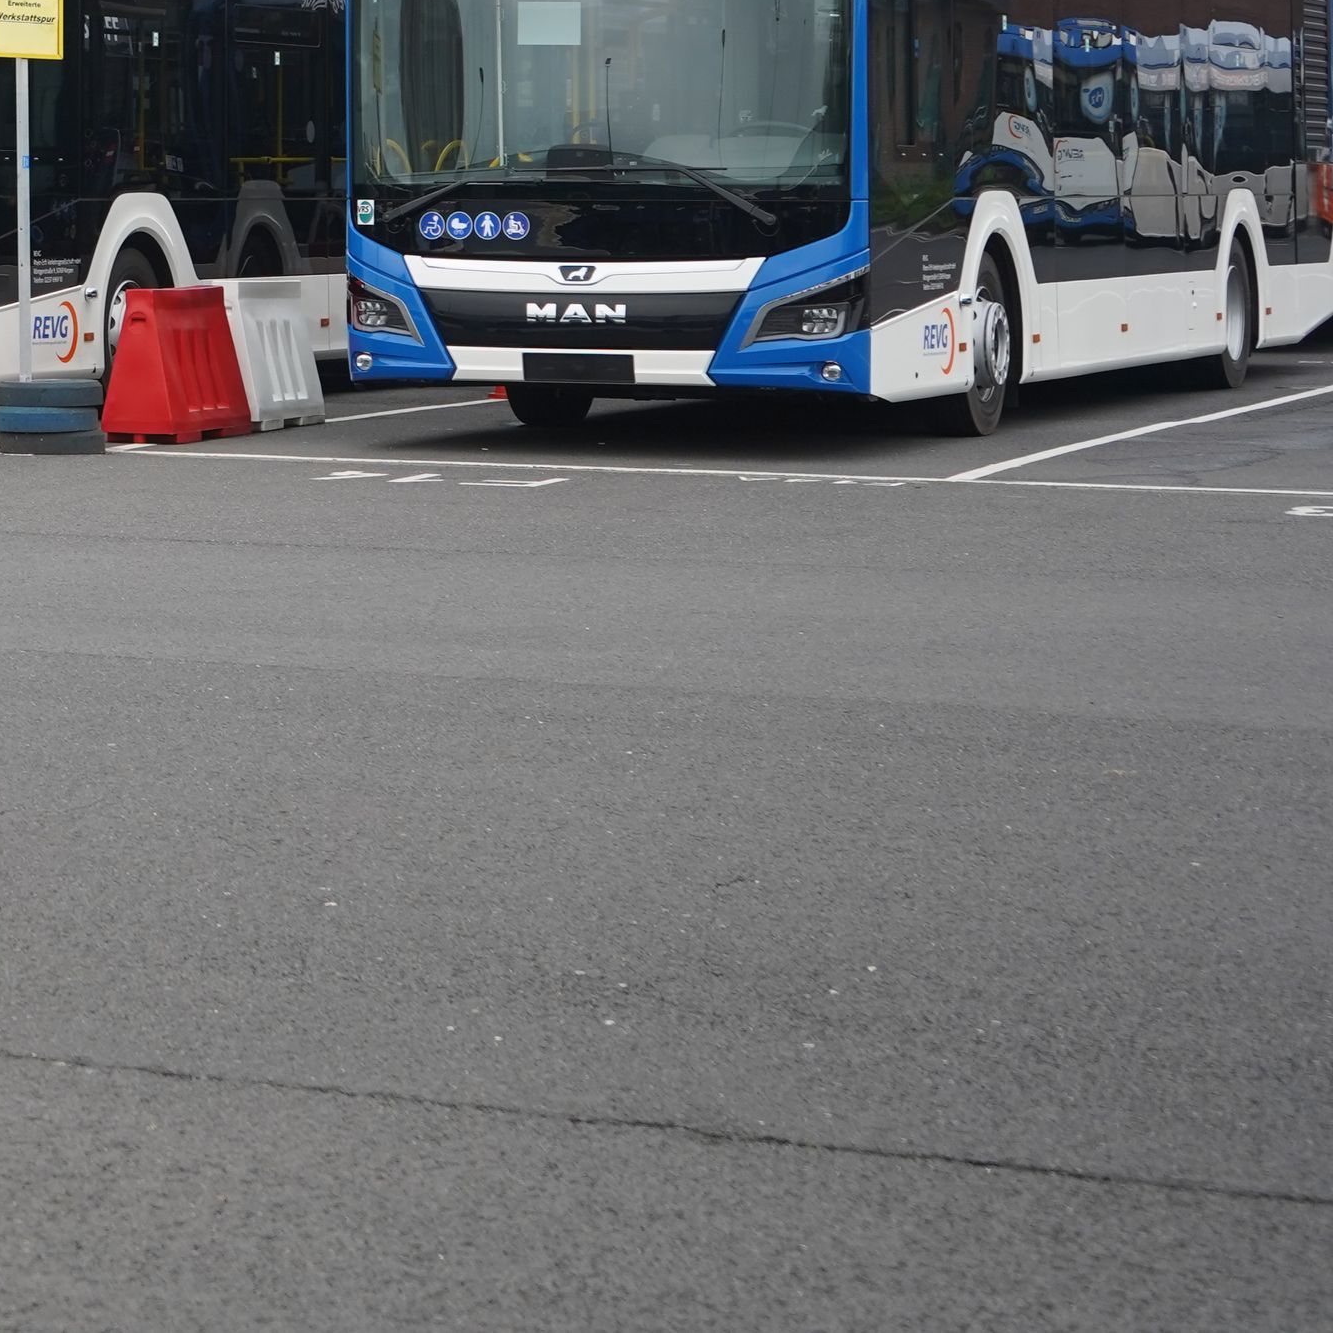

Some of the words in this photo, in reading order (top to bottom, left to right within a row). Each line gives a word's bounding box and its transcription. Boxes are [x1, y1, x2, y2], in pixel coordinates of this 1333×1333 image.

[7, 0, 42, 8] Erweiterte
[526, 303, 626, 323] MAN
[33, 315, 69, 339] REVG
[923, 323, 948, 349] REVG
